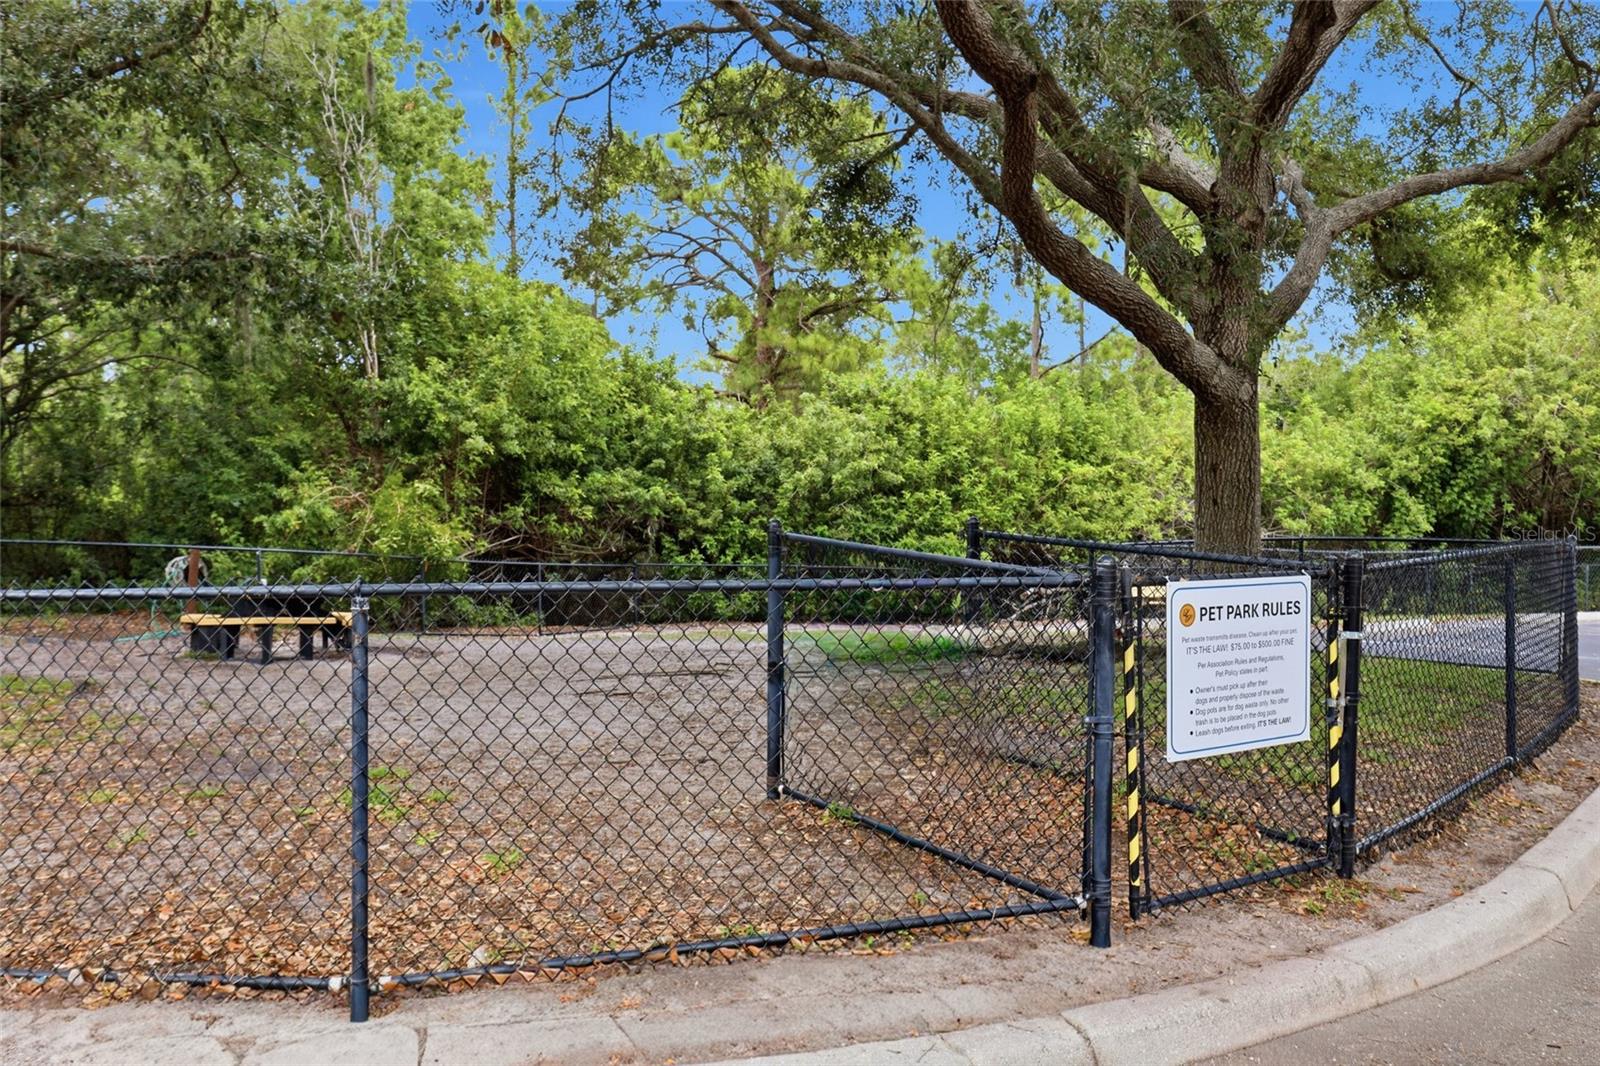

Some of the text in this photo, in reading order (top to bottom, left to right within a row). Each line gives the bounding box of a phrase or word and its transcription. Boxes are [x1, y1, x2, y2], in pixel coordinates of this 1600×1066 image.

[1200, 600, 1300, 621] PET PARK RULES
[1186, 646, 1198, 655] IT'S
[1199, 645, 1211, 654] THE
[1212, 643, 1229, 653] LAW!
[1231, 641, 1250, 652] $75.00
[1258, 639, 1280, 648] $500.00
[1281, 637, 1294, 646] FINE
[1207, 659, 1233, 668] Association
[1224, 669, 1238, 677] Policy
[1229, 683, 1239, 691] pick
[1247, 680, 1257, 688] after
[1258, 679, 1268, 687] their
[1195, 697, 1207, 705] dogs
[1208, 695, 1218, 703] and
[1219, 693, 1238, 703] properly
[1240, 691, 1256, 700] dispose
[1195, 708, 1206, 716] Dog
[1234, 703, 1244, 711] dog
[1245, 701, 1258, 709] waste
[1227, 713, 1243, 722] placed
[1195, 729, 1211, 737] Leash
[1212, 727, 1224, 735] dogs
[1225, 725, 1240, 733] before
[1257, 719, 1267, 728] IT'S
